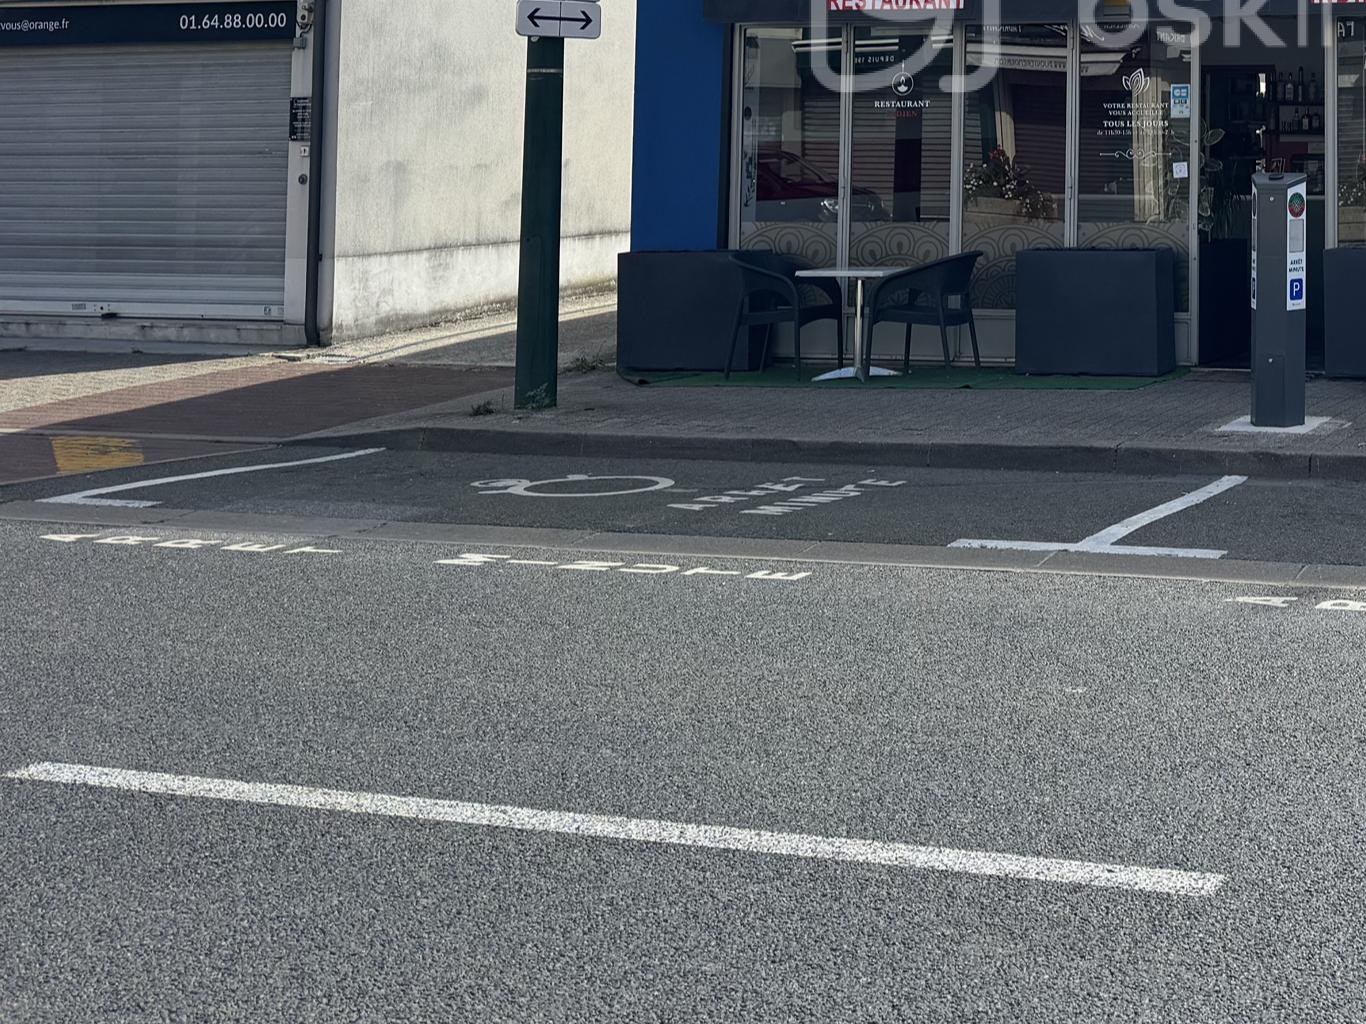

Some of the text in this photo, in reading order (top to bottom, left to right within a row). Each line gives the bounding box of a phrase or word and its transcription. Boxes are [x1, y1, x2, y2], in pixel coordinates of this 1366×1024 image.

[179, 12, 287, 30] 01.64.88.00.00
[874, 100, 930, 108] RESTAURANT
[1103, 120, 1169, 129] TOUS LES JOURS
[739, 478, 907, 516] MINUTE
[39, 533, 812, 580] ARRET MINUTE
